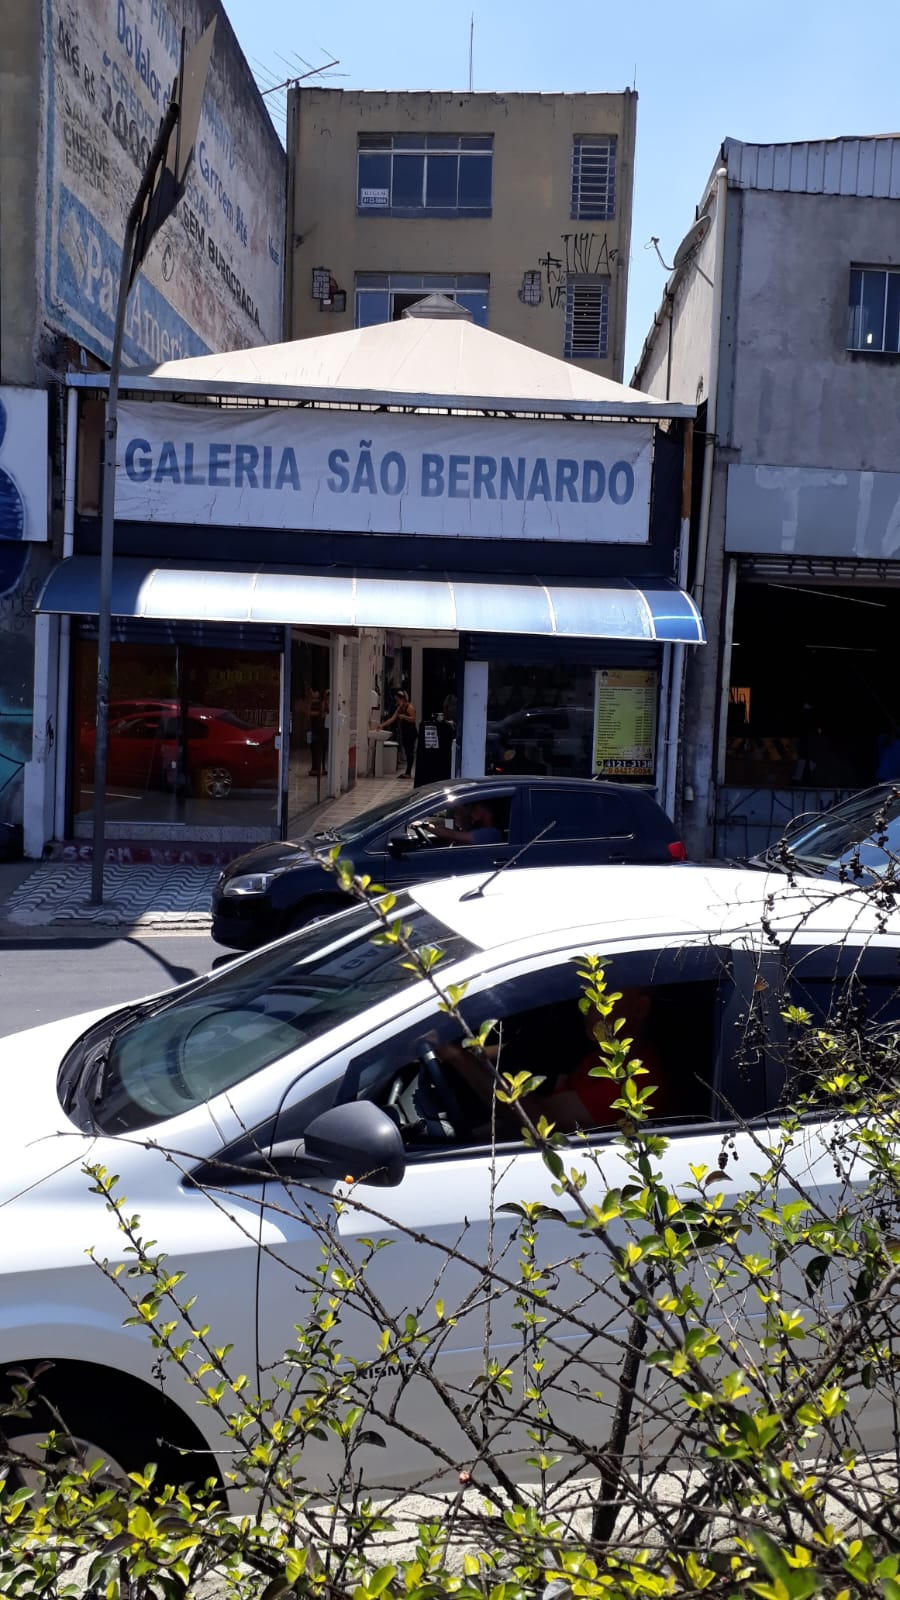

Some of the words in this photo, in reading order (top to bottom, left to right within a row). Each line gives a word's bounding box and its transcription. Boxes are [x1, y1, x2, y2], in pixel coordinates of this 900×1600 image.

[208, 236, 260, 329] BUROCRACIA
[125, 438, 301, 491] GALERIA
[327, 440, 407, 496] SÃO
[420, 453, 635, 505] BERNARDO
